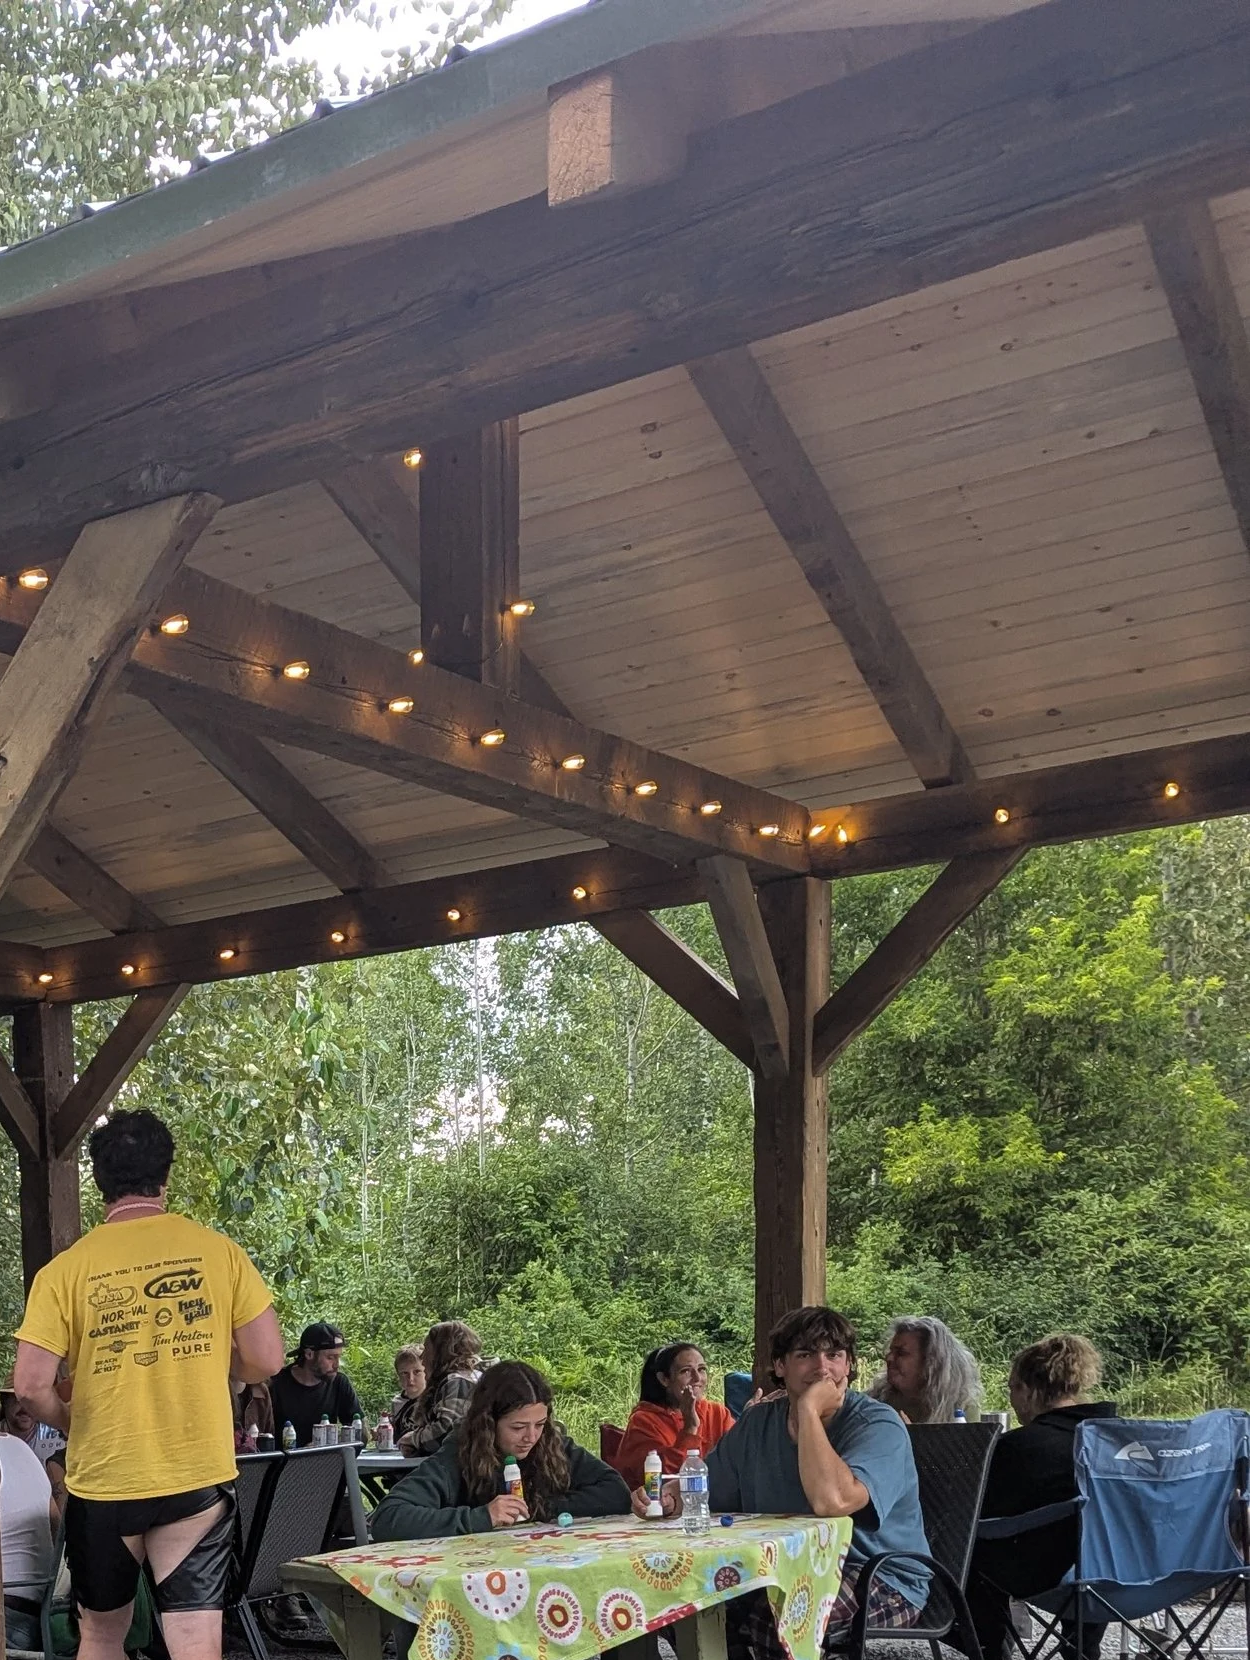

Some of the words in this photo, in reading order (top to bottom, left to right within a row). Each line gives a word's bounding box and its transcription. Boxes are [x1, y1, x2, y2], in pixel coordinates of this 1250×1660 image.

[144, 1262, 161, 1270] OUR
[163, 1257, 203, 1266] SPONSORS
[154, 1276, 204, 1297] A&W
[100, 1304, 149, 1325] NOR-VAL
[88, 1320, 141, 1338] CASTANET
[151, 1332, 172, 1347] Tim
[172, 1329, 214, 1344] Hortons
[172, 1342, 211, 1357] PURE
